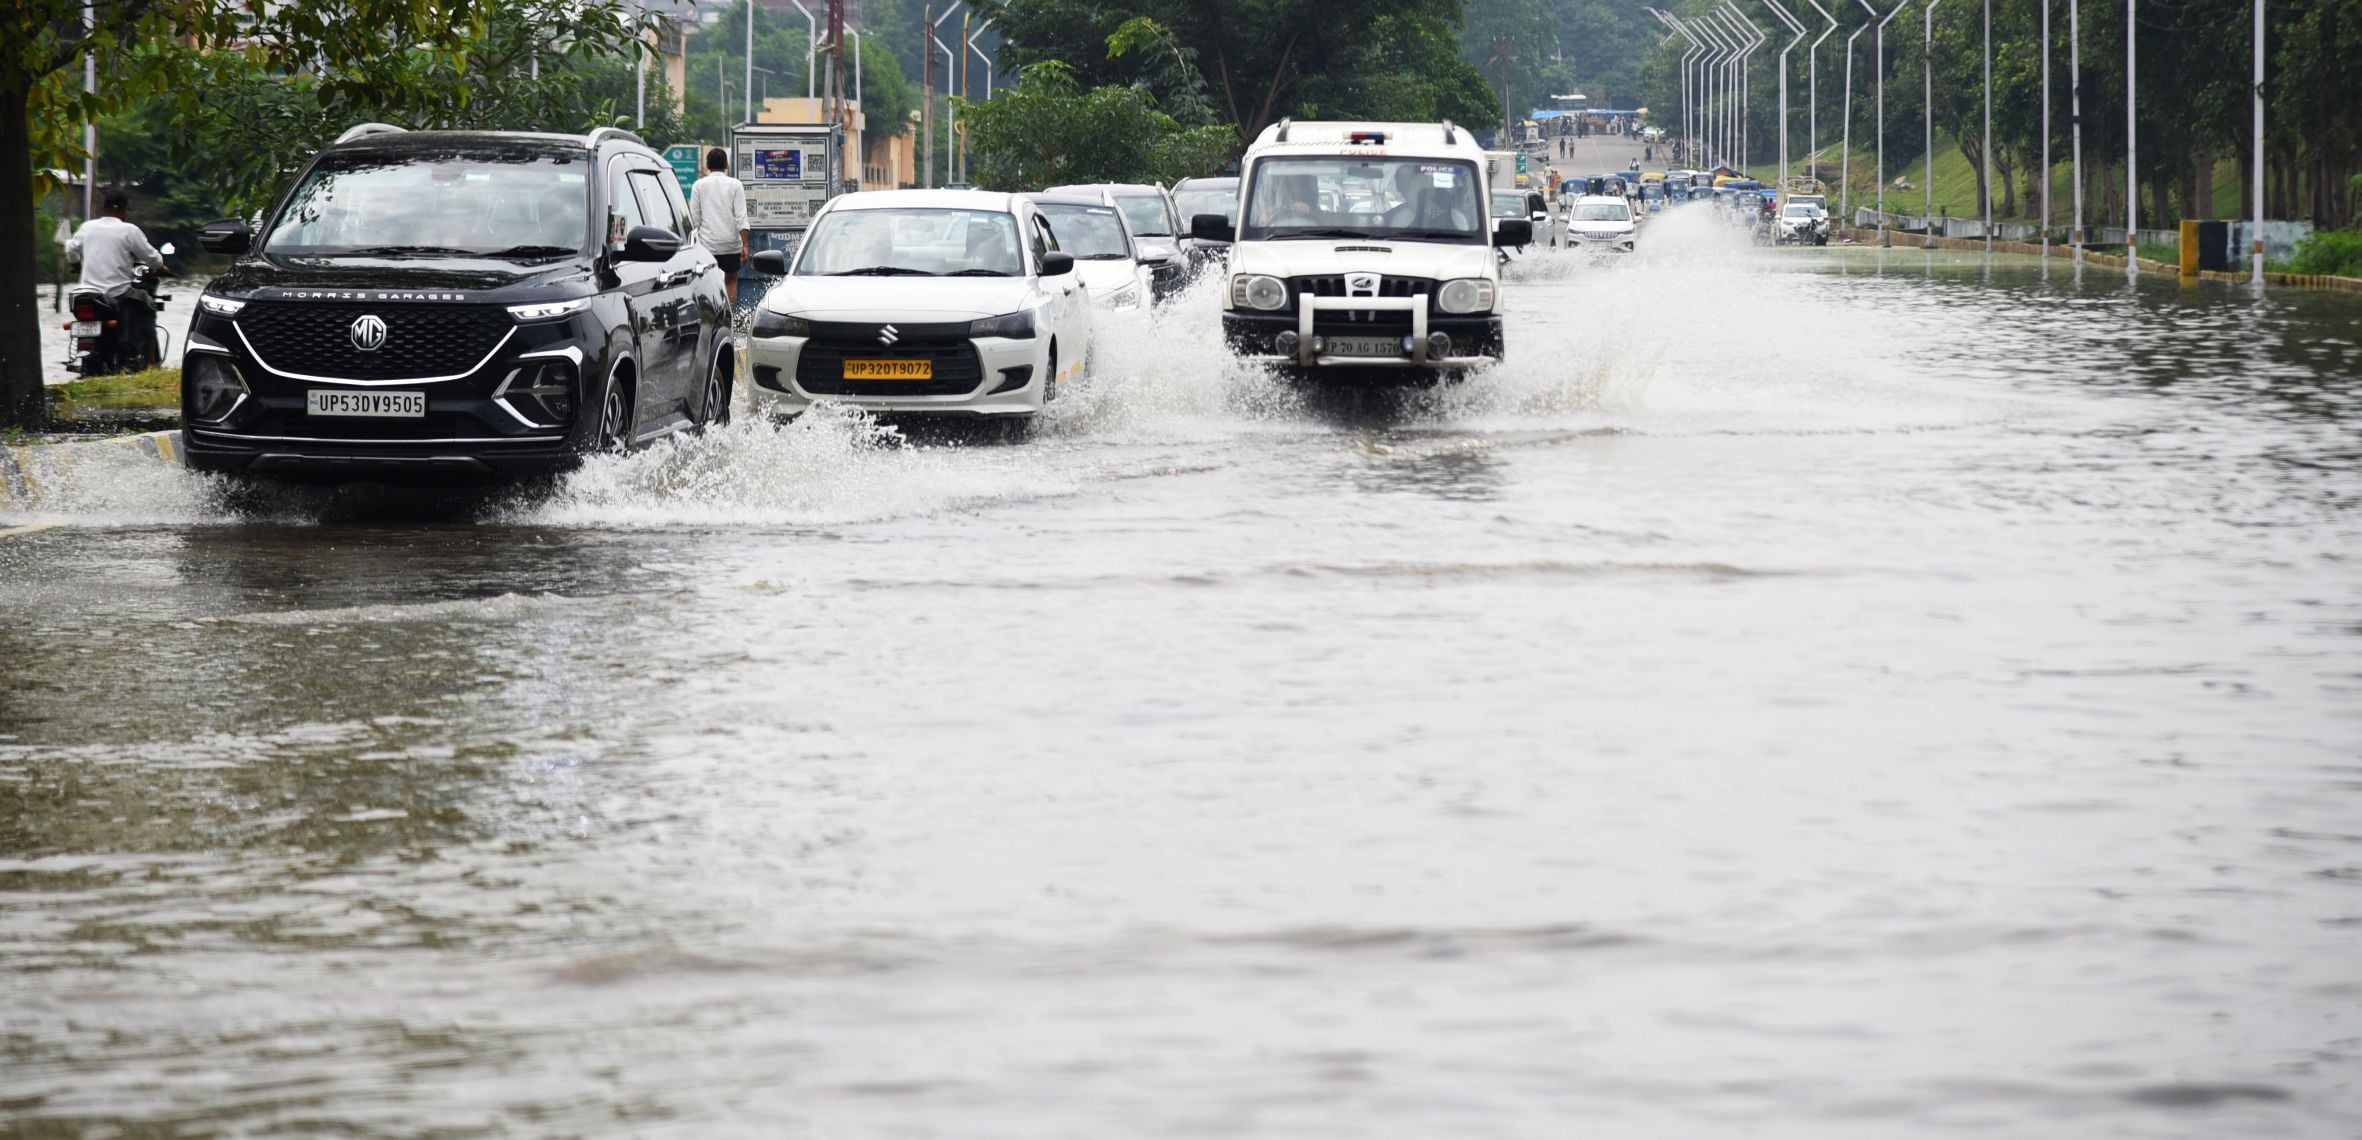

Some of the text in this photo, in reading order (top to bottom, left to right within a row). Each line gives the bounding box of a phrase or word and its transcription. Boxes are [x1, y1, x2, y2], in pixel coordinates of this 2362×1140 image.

[1420, 165, 1454, 173] POLICE
[282, 291, 465, 301] MORRIS GARAGES
[353, 317, 383, 348] MG
[1340, 342, 1352, 353] 70
[1357, 342, 1370, 353] AG
[1375, 342, 1400, 353] 1570
[319, 394, 422, 413] UP53DV9505
